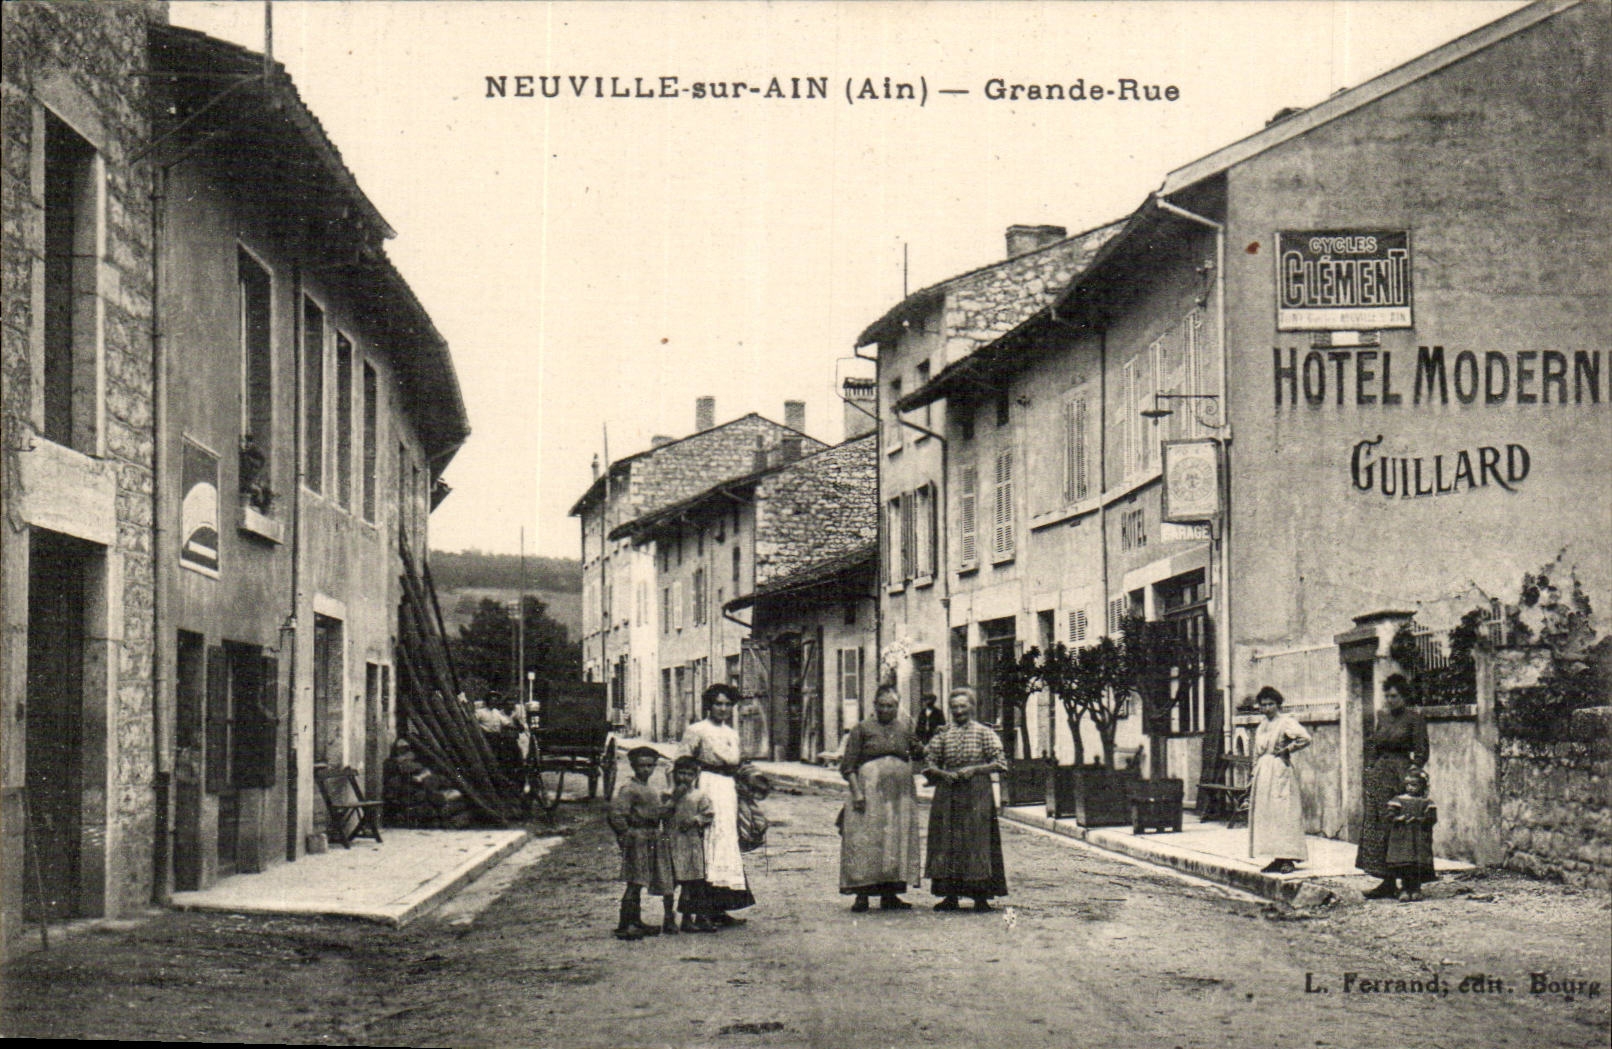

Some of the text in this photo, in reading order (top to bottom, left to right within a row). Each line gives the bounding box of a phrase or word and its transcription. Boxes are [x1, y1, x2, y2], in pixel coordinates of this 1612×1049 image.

[1309, 236, 1378, 254] CYCLES
[1282, 249, 1408, 307] CLÉMENT
[1413, 346, 1612, 405] MODERN
[1351, 434, 1531, 496] GUILLARD
[1121, 510, 1147, 553] HOTEL
